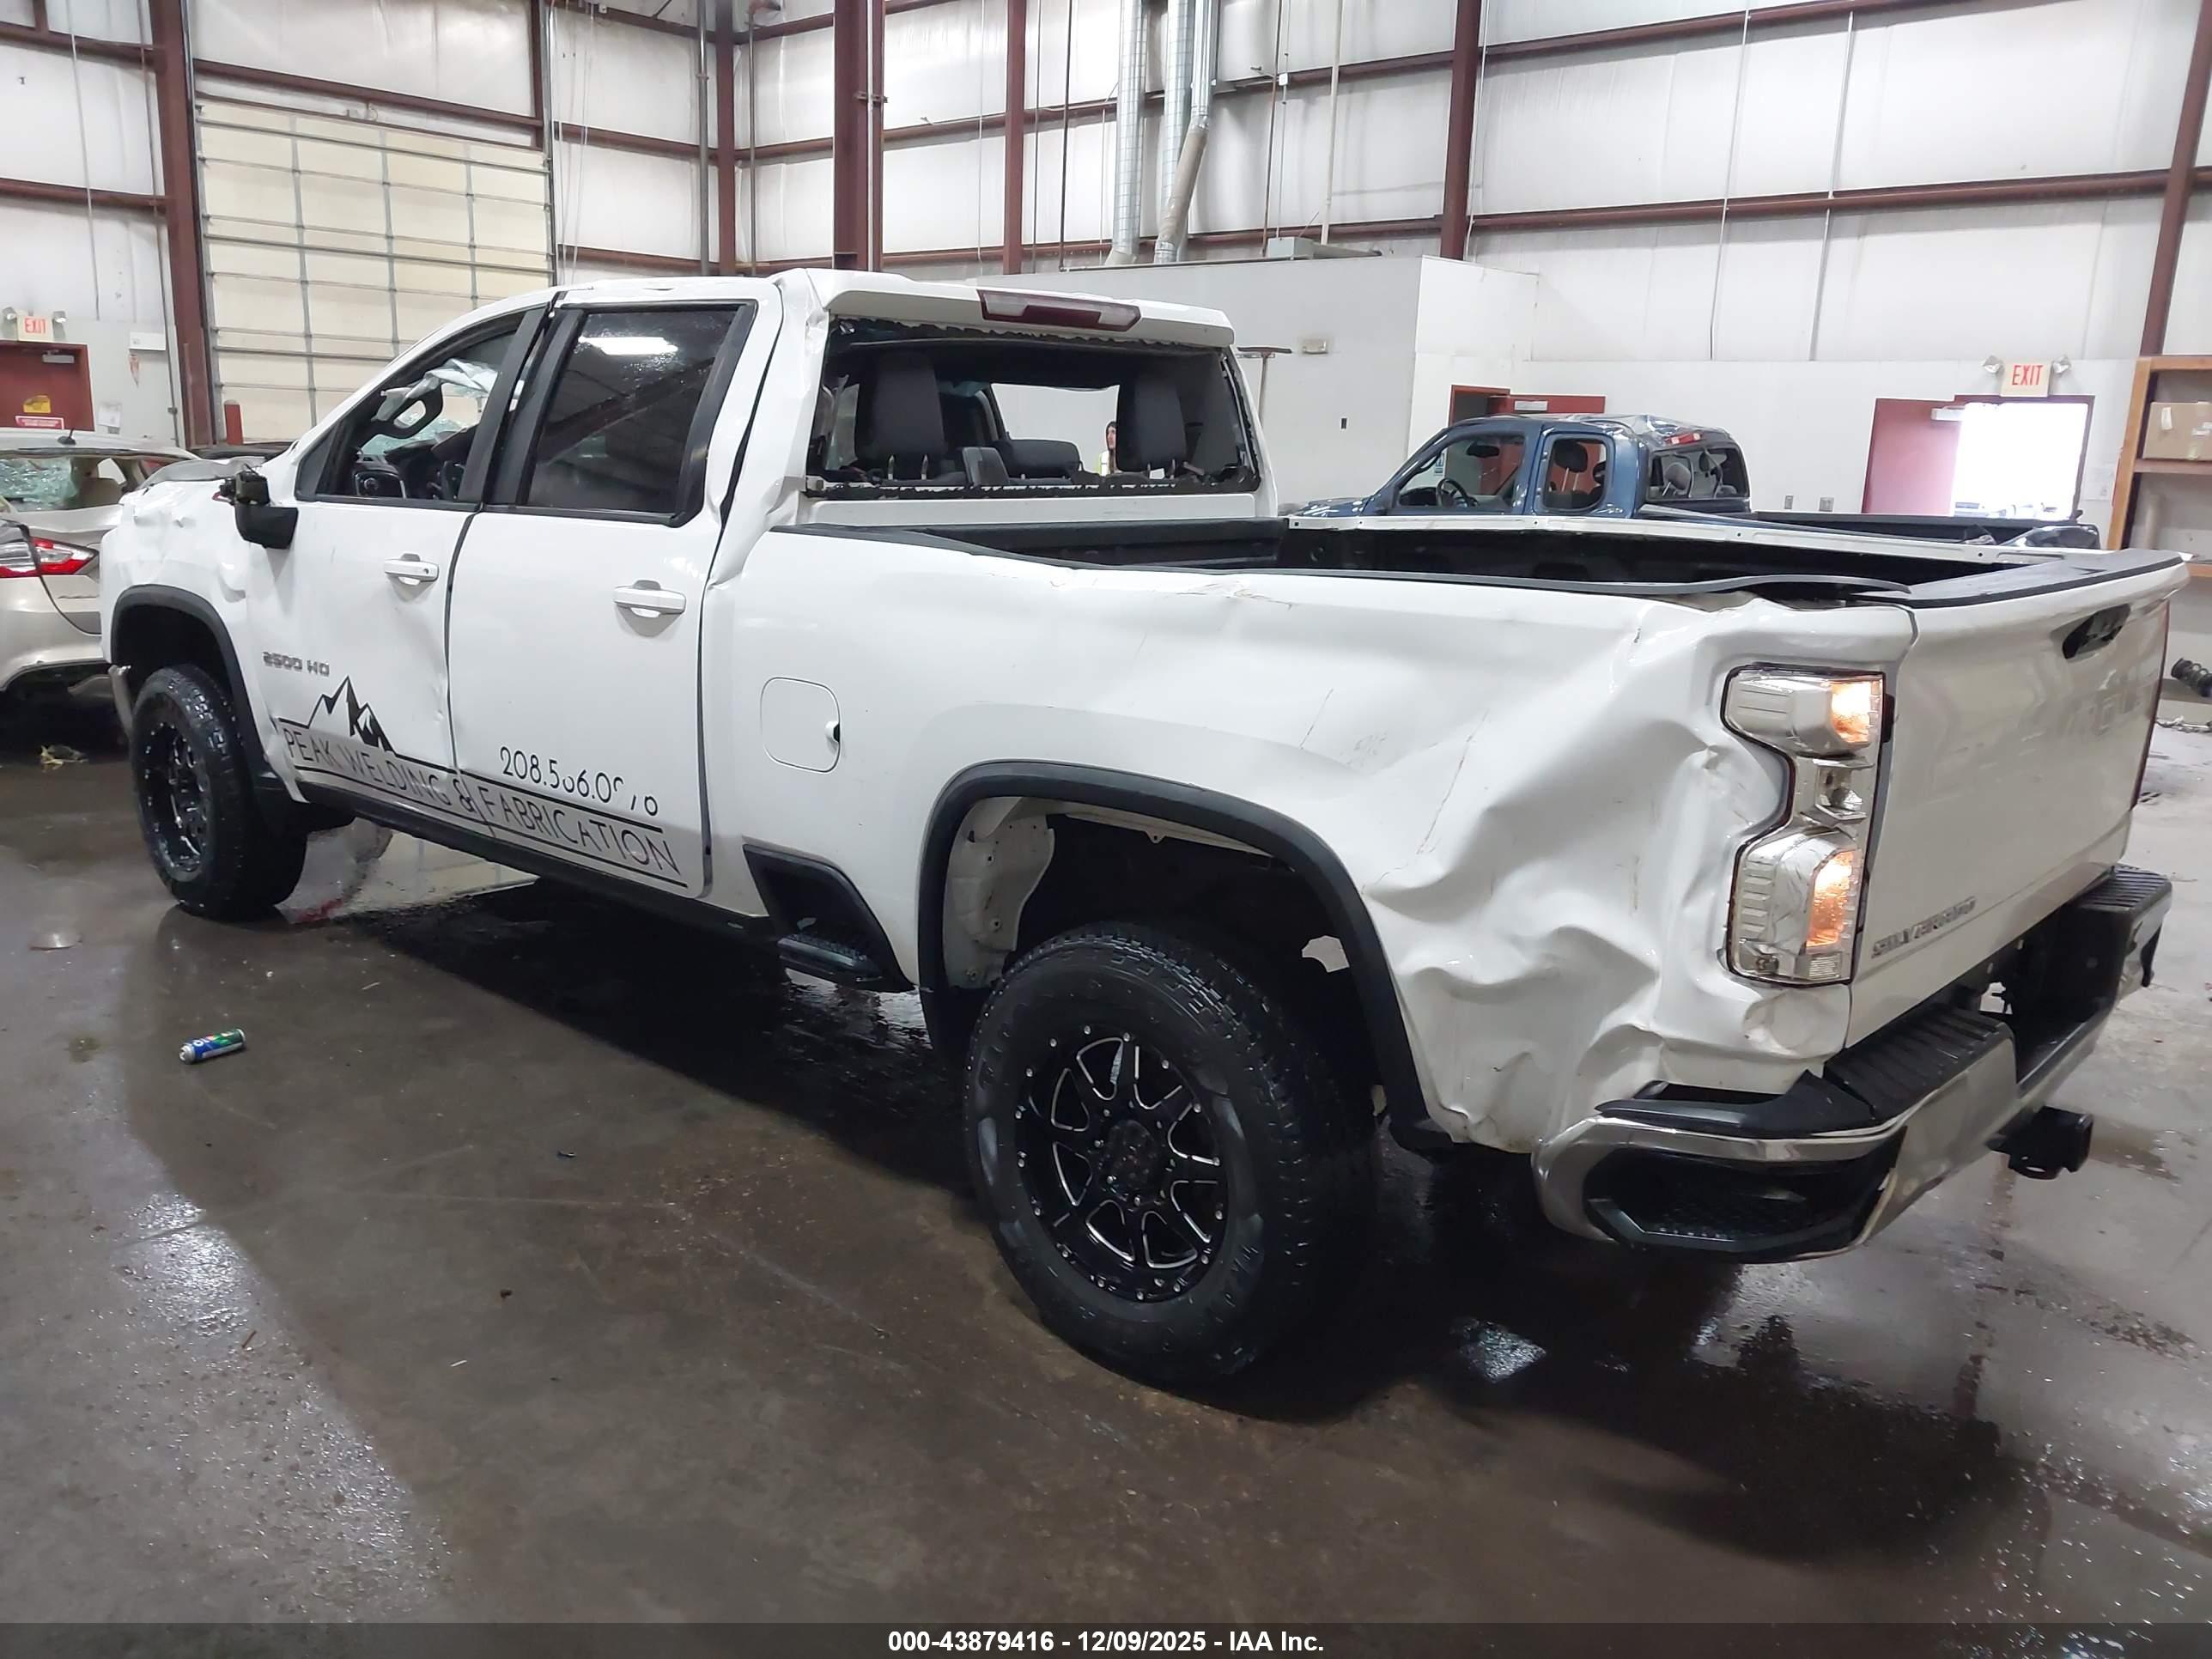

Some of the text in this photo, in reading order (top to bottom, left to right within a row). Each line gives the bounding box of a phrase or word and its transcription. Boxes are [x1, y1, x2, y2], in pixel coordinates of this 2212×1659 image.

[24, 317, 46, 334] EXIT
[2012, 364, 2044, 386] EXIT
[262, 651, 330, 678] 2500 HD
[283, 727, 682, 876] PEAK WELDING & FABRICATION
